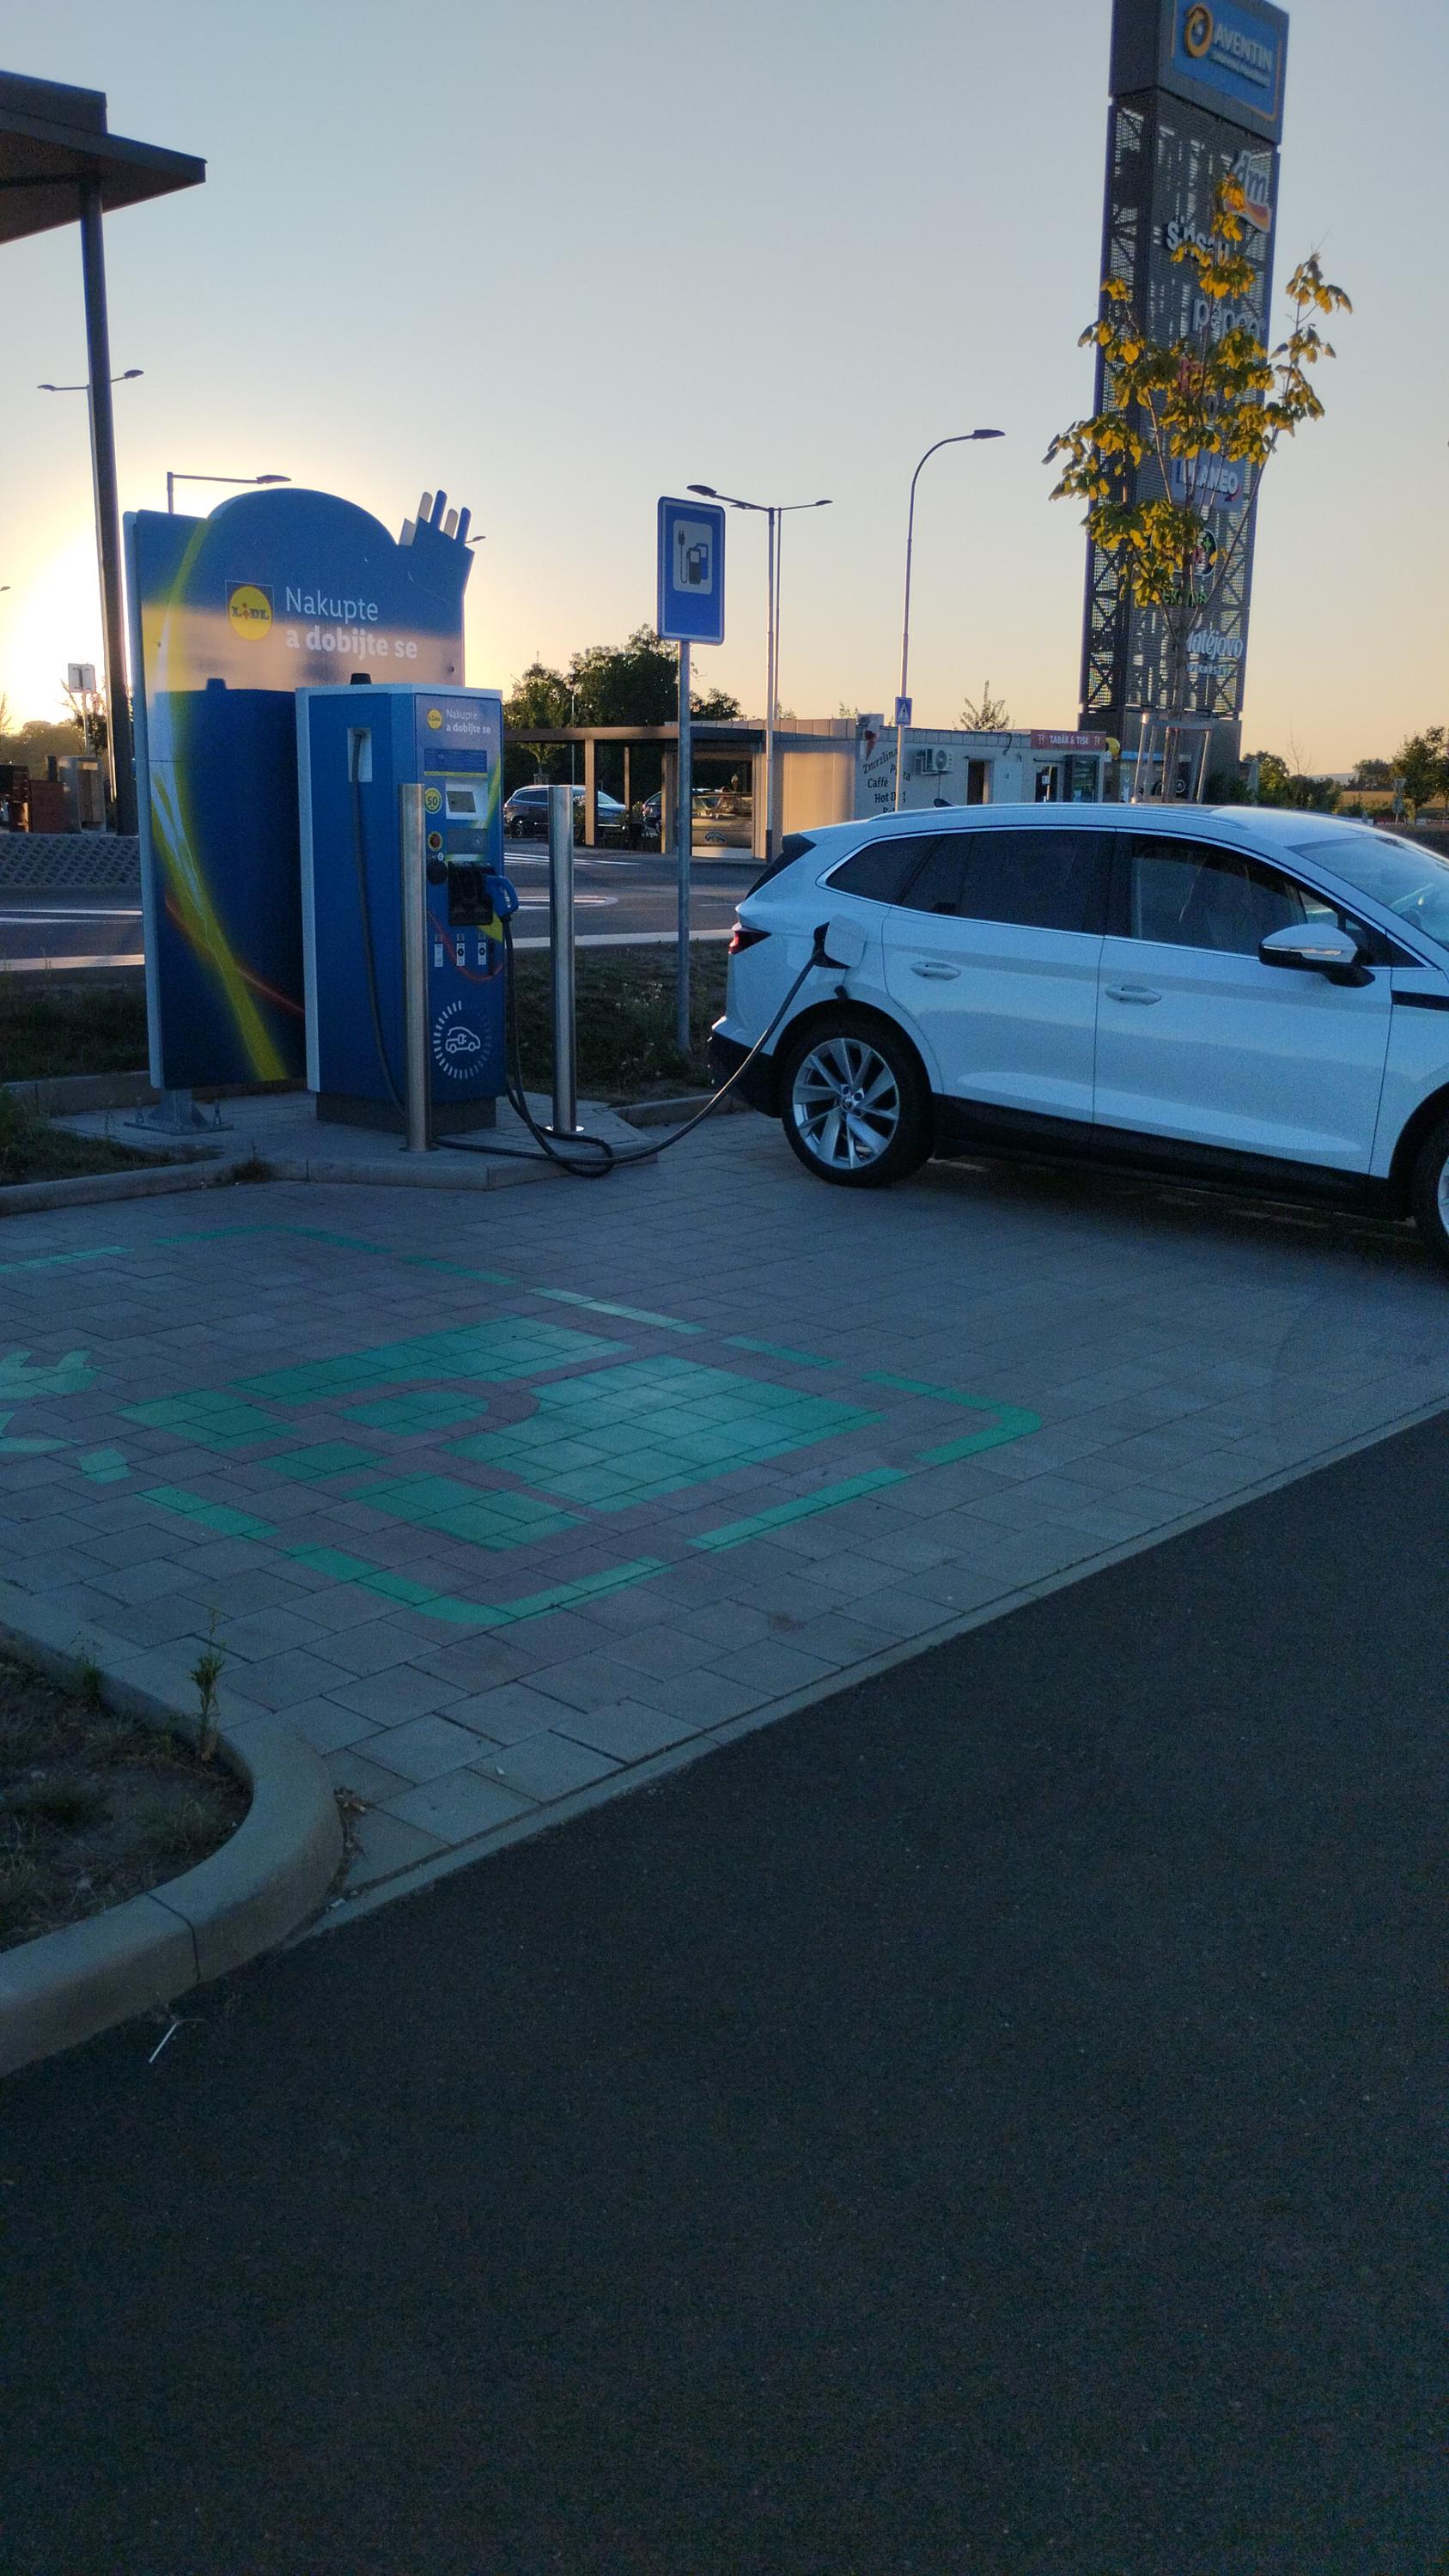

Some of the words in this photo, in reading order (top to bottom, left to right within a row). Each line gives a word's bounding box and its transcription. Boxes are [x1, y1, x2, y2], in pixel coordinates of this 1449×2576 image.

[1213, 23, 1273, 70] AVENTIN
[285, 586, 379, 624] Nakupte
[286, 629, 300, 648] a
[305, 625, 388, 661] dobijte
[394, 639, 417, 659] se
[446, 708, 478, 720] Nakupte
[452, 722, 481, 735] dobijte
[867, 776, 888, 788] Caffe
[427, 796, 438, 805] 50
[874, 792, 890, 804] Hot
